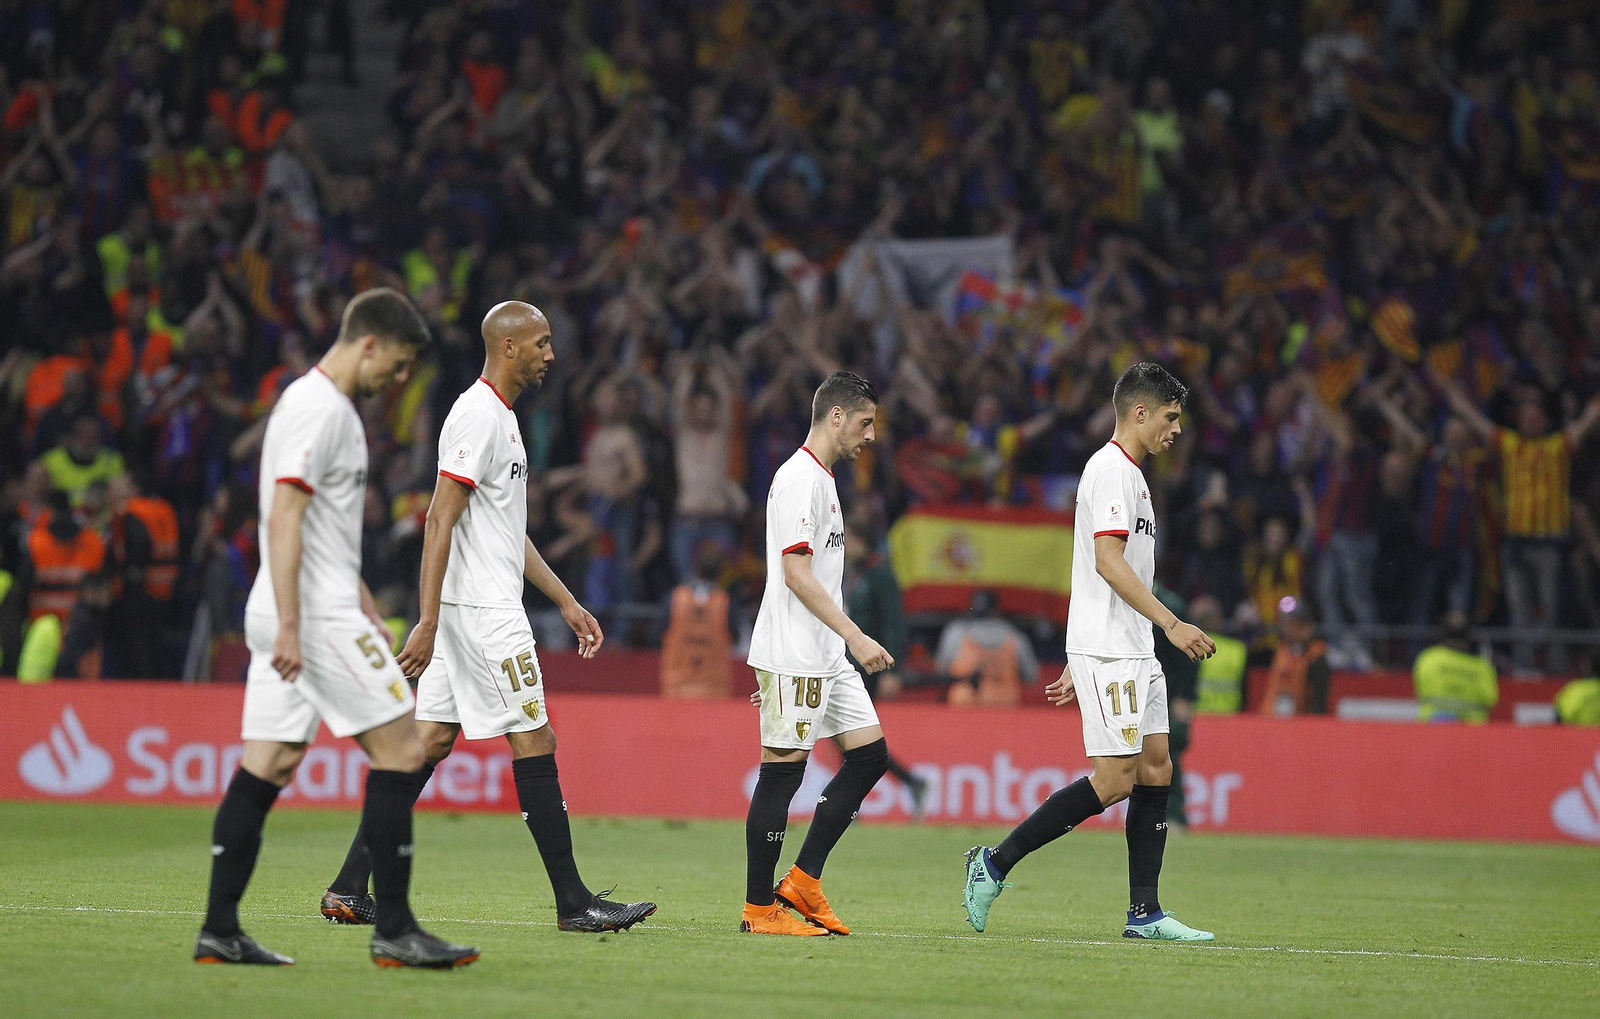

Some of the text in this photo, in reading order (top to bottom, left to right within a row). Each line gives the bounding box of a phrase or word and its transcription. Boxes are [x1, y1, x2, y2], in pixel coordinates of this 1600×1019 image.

[356, 632, 386, 669] 5
[501, 650, 538, 692] 15
[792, 676, 822, 709] 18
[1106, 680, 1138, 715] 11
